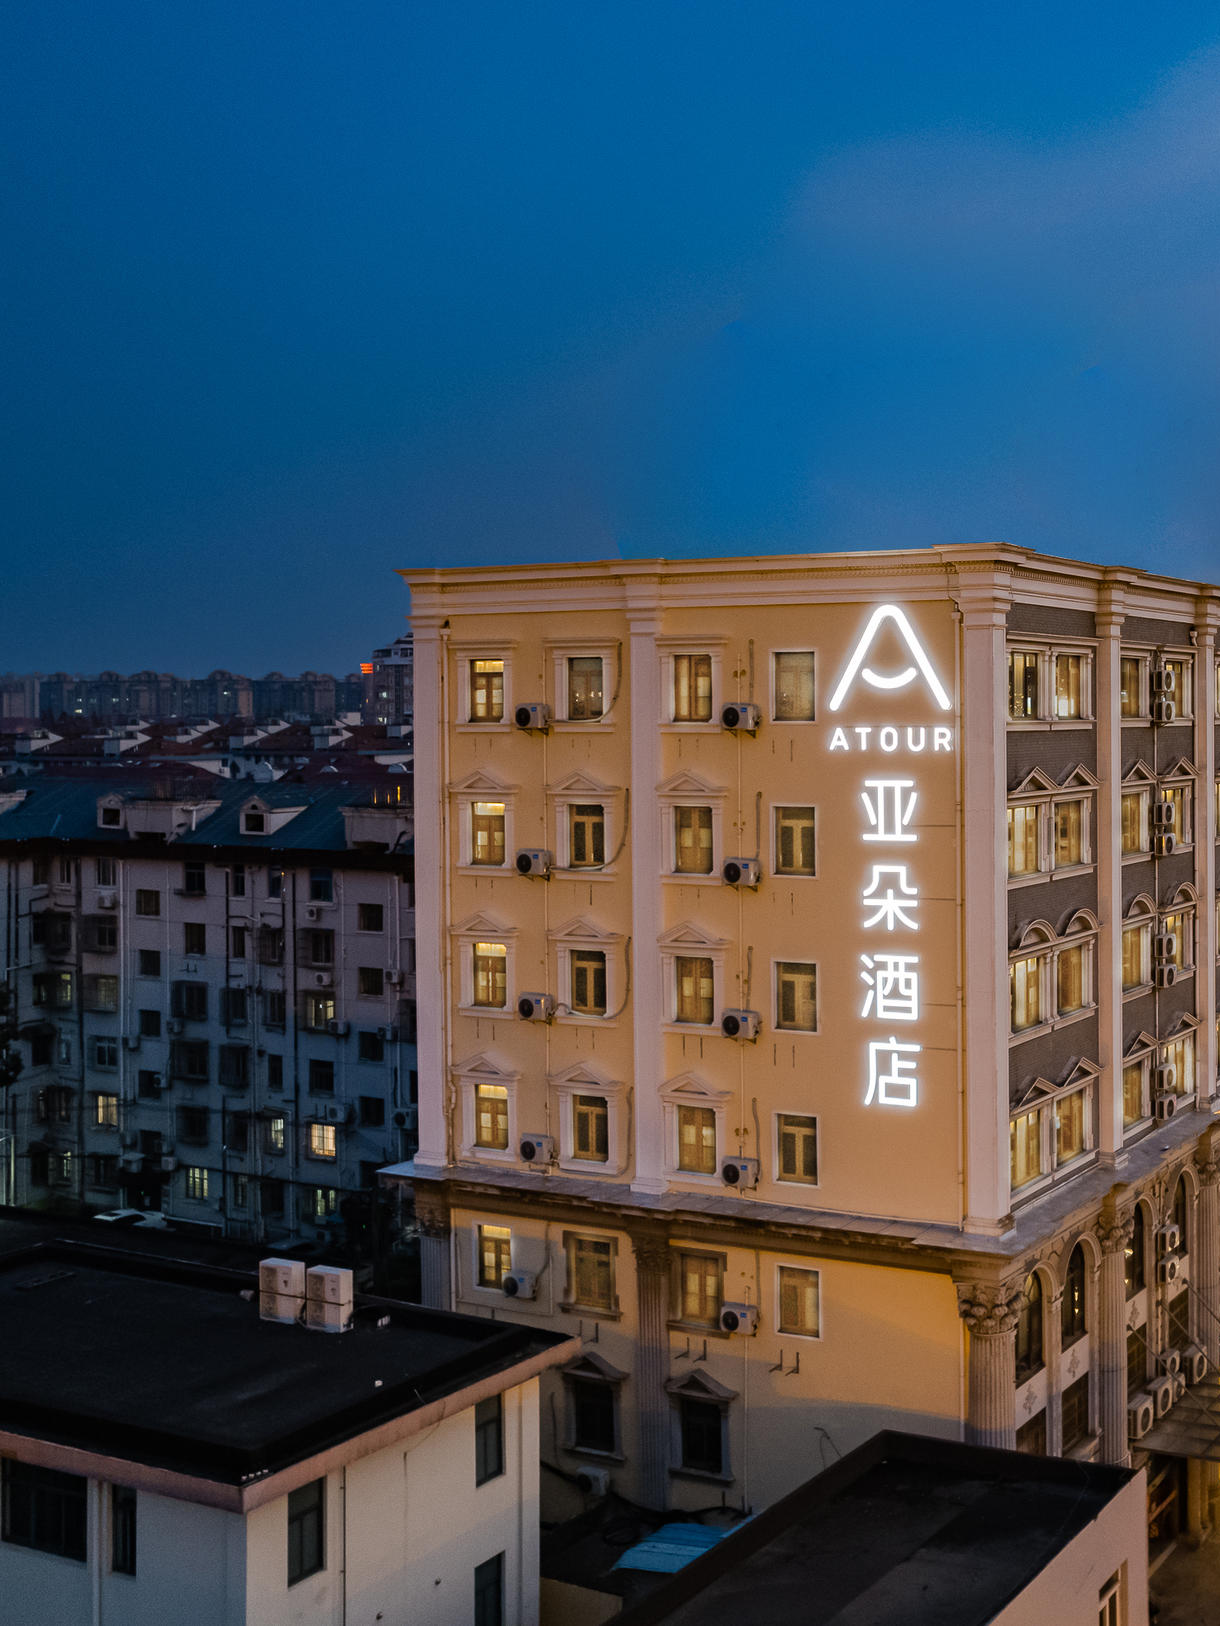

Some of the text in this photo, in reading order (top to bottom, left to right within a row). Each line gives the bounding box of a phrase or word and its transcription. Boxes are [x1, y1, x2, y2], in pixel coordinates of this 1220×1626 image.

[829, 727, 952, 752] ATOUR
[860, 780, 922, 1108] 亚朵酒店
